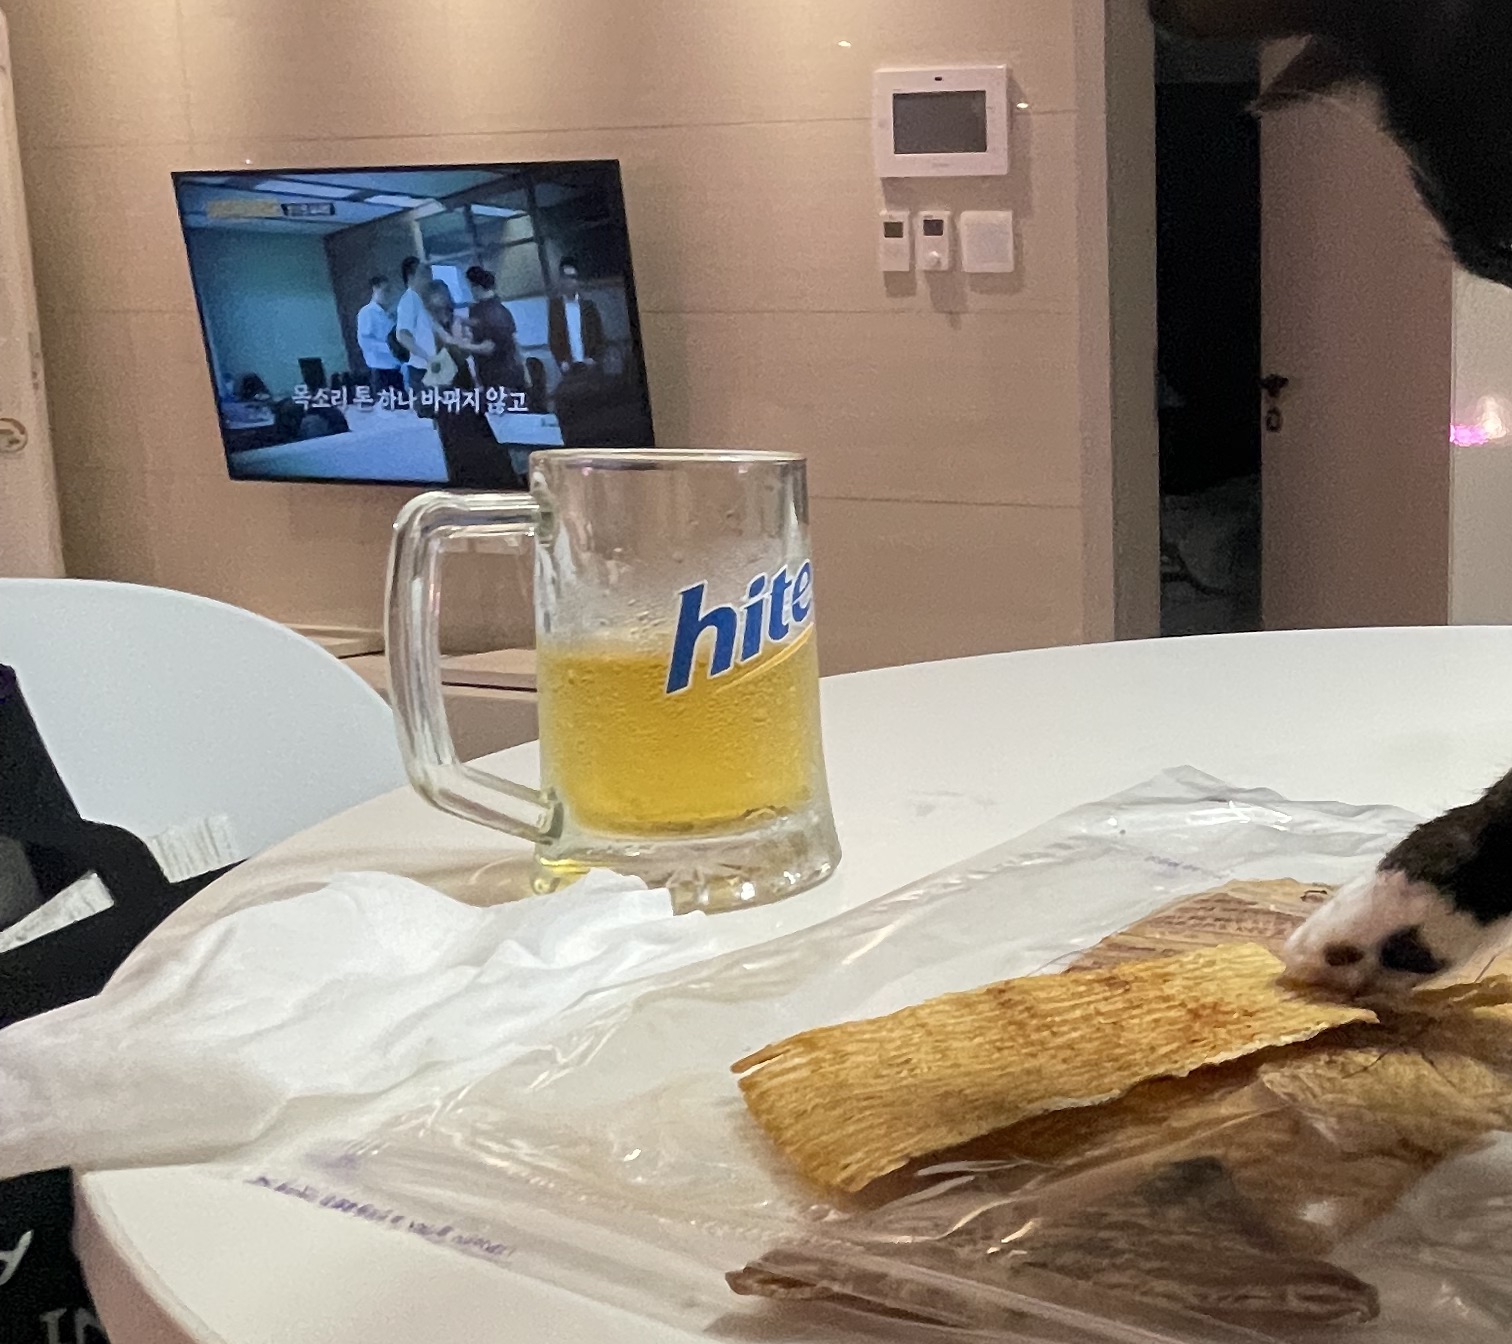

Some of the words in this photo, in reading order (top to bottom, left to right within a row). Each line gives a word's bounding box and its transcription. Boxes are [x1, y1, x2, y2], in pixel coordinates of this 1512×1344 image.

[291, 383, 348, 413] 목소리
[352, 384, 374, 411] 톤
[377, 385, 417, 412] 하나
[420, 385, 480, 415] 바뀌지
[485, 385, 529, 415] 않고
[664, 558, 813, 695] hite
